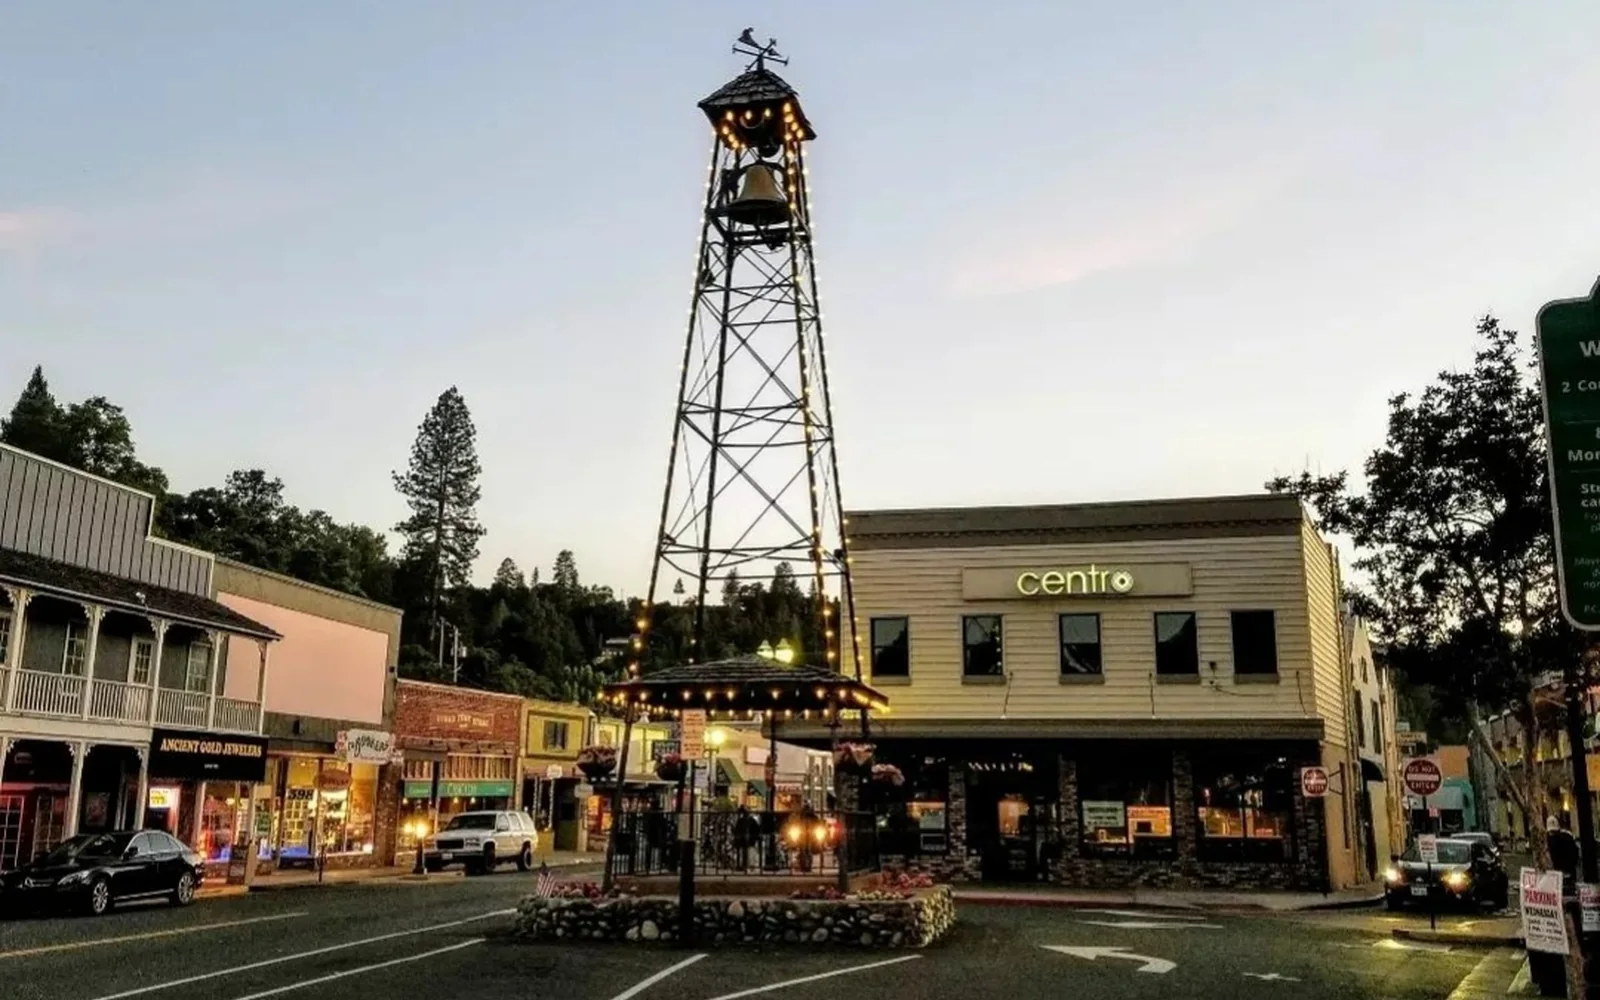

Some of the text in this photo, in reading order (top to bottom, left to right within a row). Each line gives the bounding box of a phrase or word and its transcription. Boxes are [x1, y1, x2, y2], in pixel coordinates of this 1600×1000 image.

[1560, 380, 1571, 393] 2
[1580, 498, 1600, 508] ca
[1017, 563, 1134, 595] centro
[160, 738, 262, 757] ANCIENT GOLD JEWELERS
[1408, 764, 1436, 773] DO NOT
[1410, 781, 1436, 790] ENTER
[287, 788, 314, 800] 598
[1524, 890, 1558, 906] PARKING
